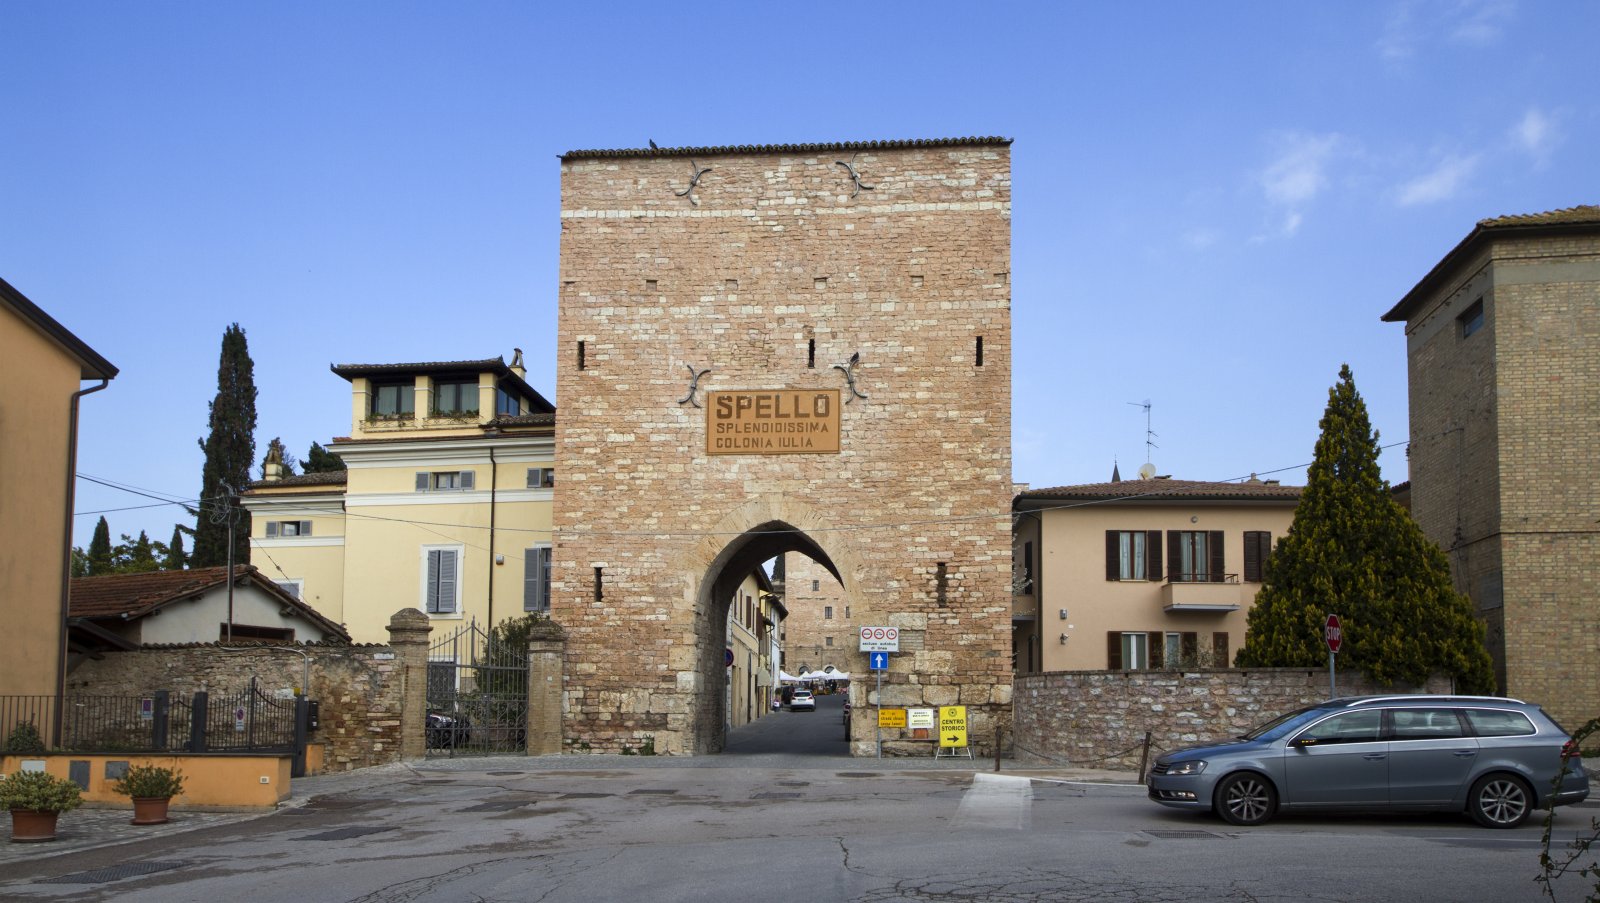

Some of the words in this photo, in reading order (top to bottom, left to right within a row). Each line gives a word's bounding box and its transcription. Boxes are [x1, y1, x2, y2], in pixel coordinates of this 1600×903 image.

[716, 394, 830, 419] SPELLO
[716, 422, 829, 434] SPLENDIDISSIMA
[716, 437, 773, 448] COLONIA
[778, 437, 813, 448] IULIA
[1326, 626, 1340, 640] STOP
